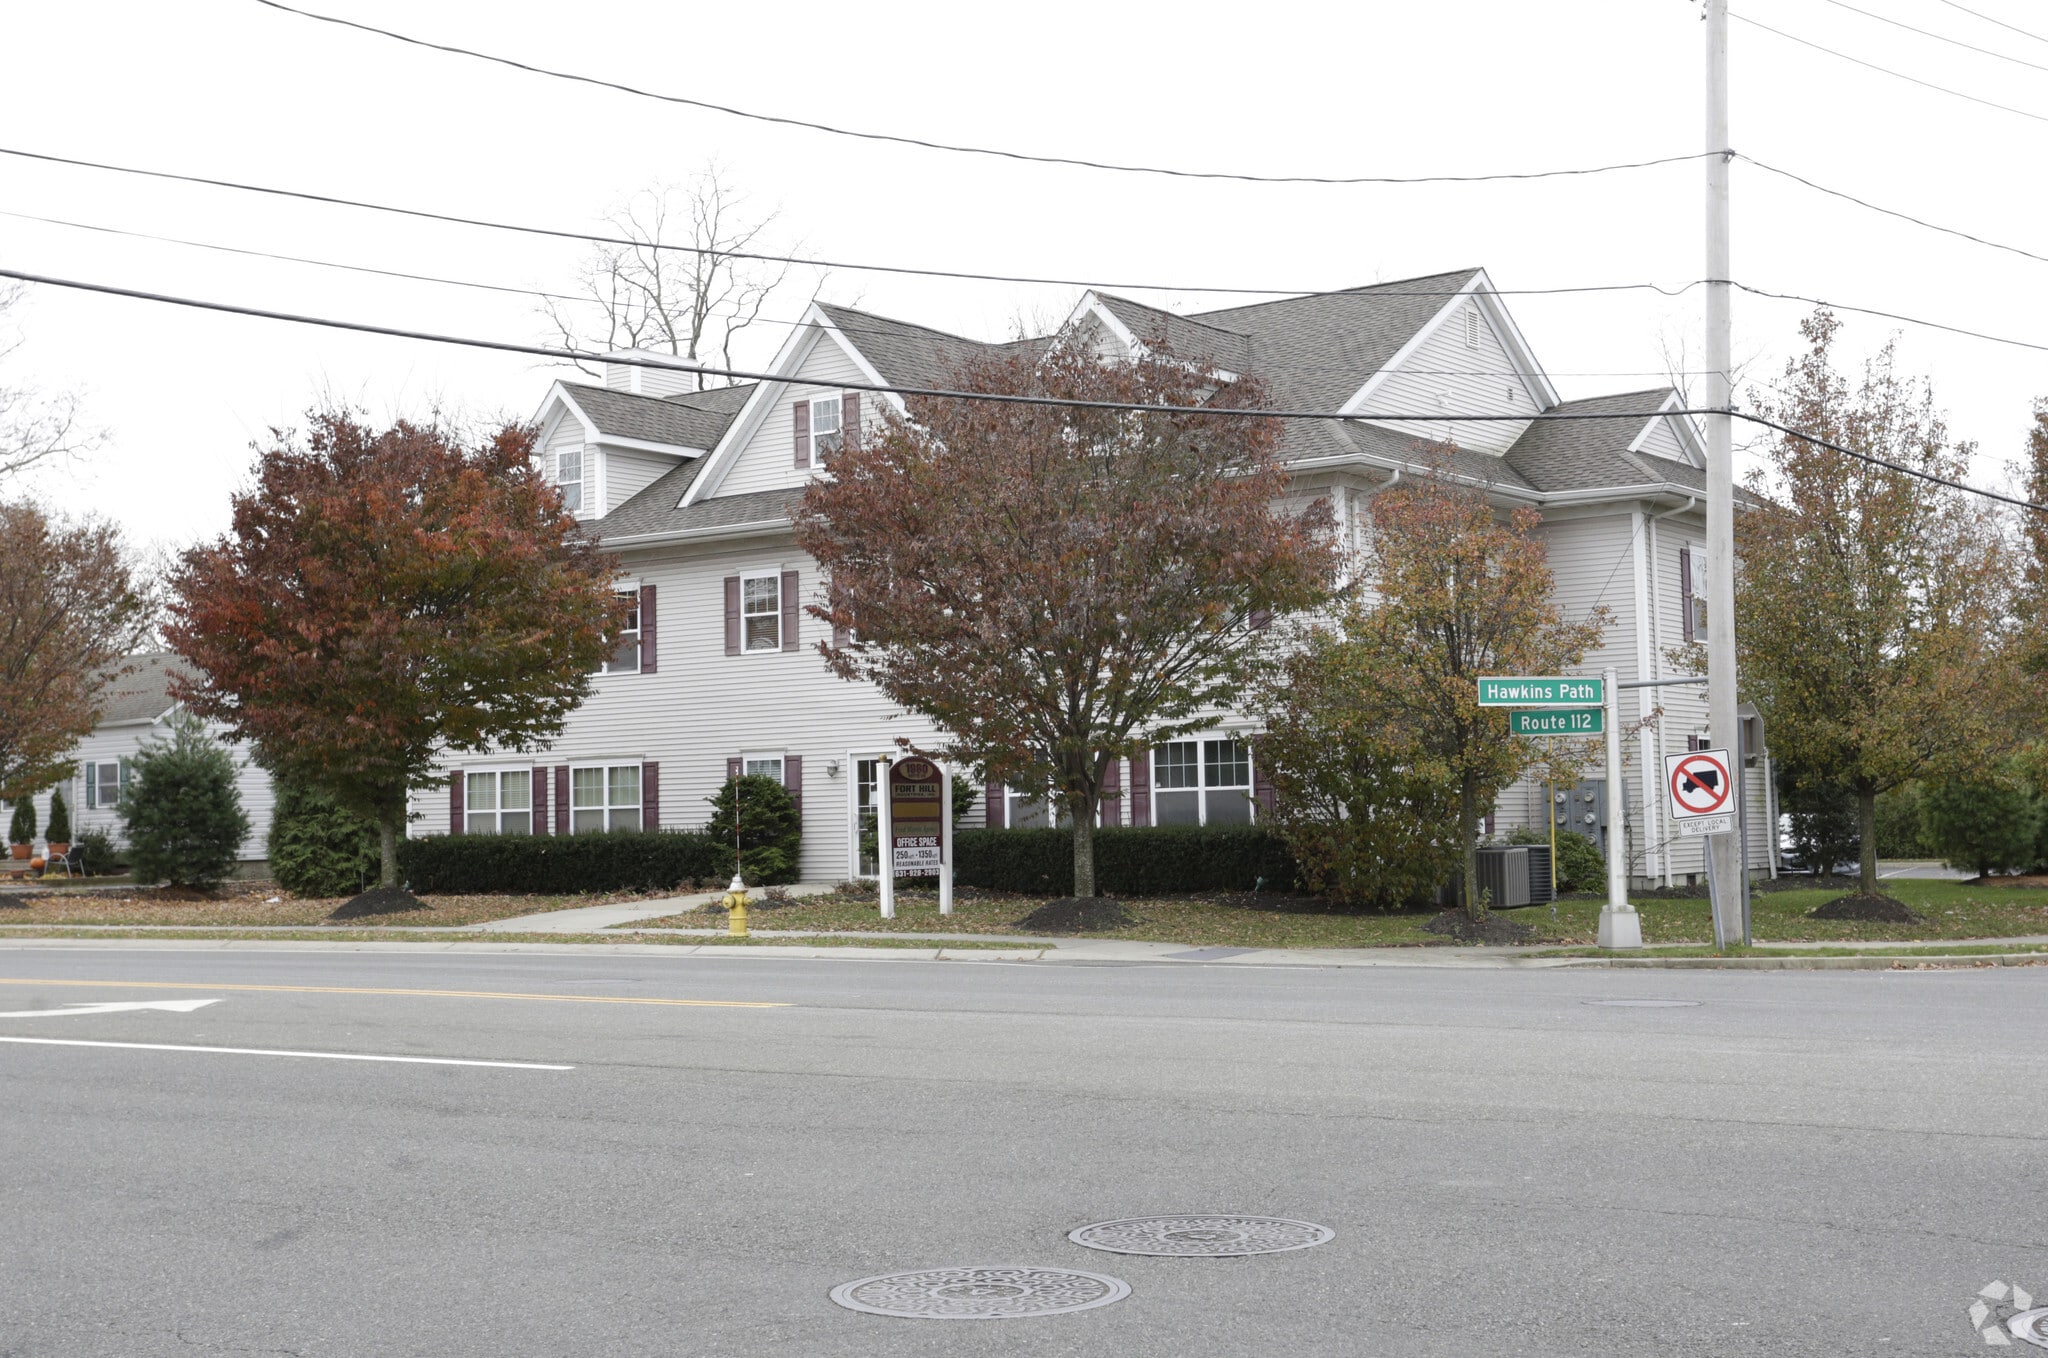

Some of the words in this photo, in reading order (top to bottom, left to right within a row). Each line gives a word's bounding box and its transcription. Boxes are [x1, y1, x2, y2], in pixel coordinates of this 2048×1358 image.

[1487, 684, 1553, 699] Hawkins
[1559, 684, 1594, 699] Path
[1521, 715, 1566, 730] Route
[1571, 714, 1592, 729] 112
[895, 785, 916, 793] FORT
[918, 785, 936, 793] HILL
[896, 837, 918, 847] OFFICE
[919, 837, 937, 846] SPACE
